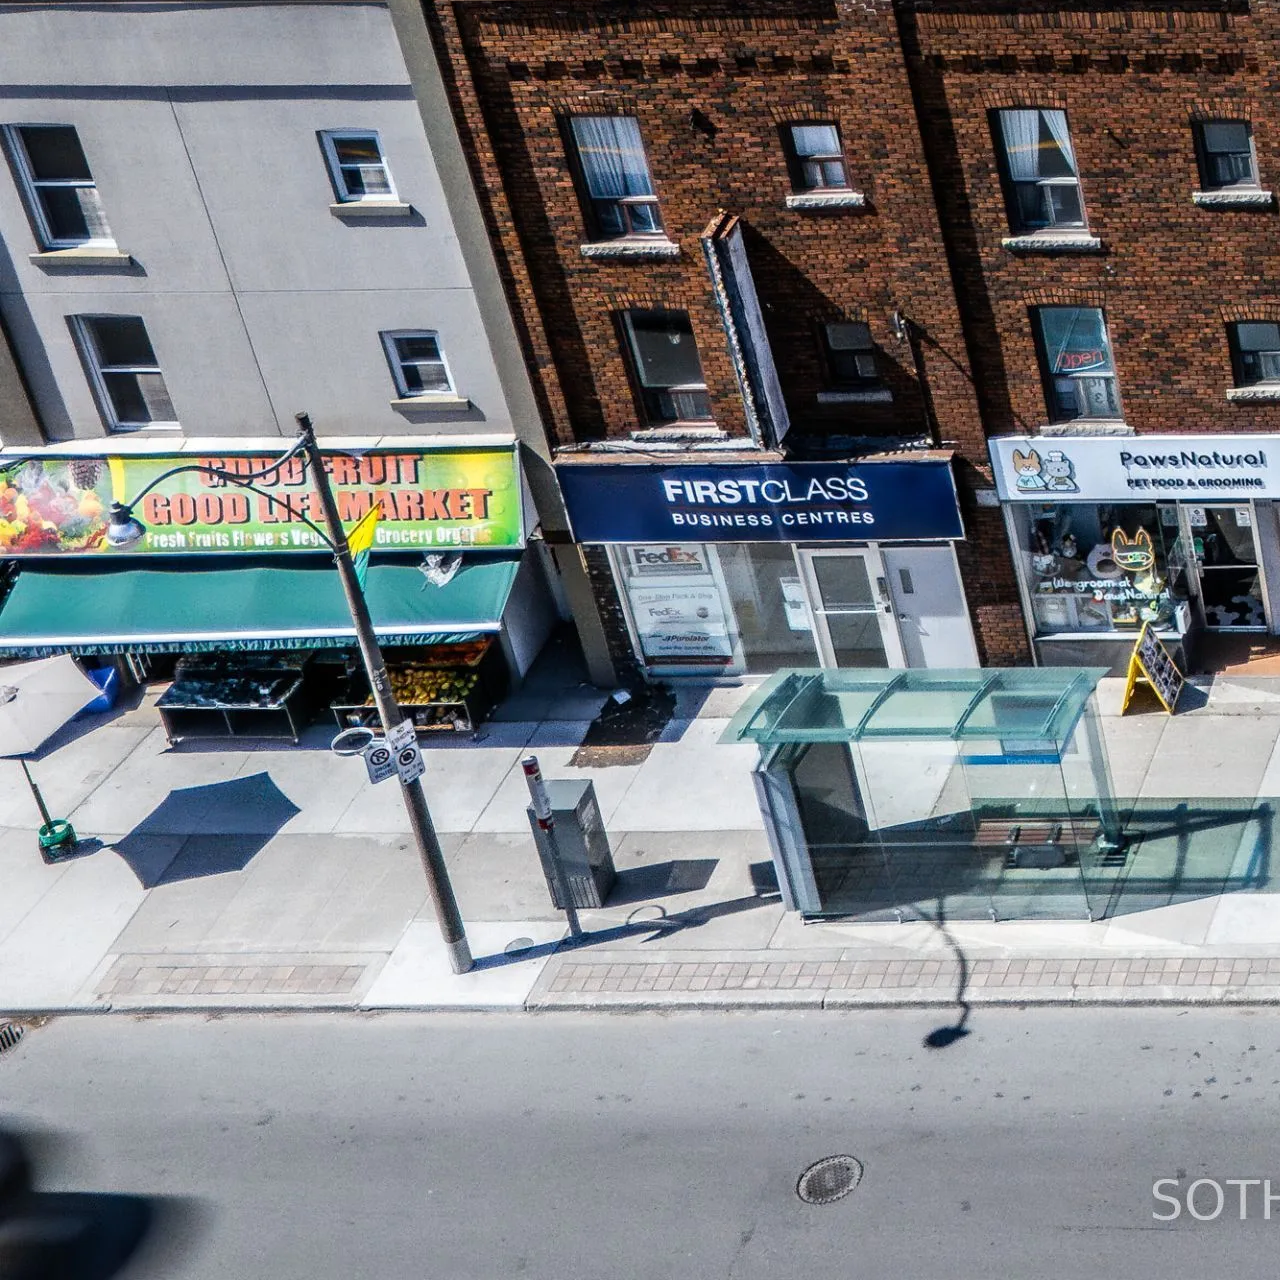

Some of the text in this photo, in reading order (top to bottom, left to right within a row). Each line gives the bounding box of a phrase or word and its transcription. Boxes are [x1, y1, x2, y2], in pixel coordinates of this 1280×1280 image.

[1119, 450, 1266, 467] PawsNatural
[199, 456, 307, 488] GOOD
[663, 477, 869, 504] FIRSTCLASS
[1127, 477, 1263, 487] PET FOOD & GROOMING
[143, 492, 251, 525] GOOD
[336, 488, 493, 522] MARKET
[672, 511, 875, 526] BUSINESS CENTRES
[146, 532, 186, 548] Fresh
[188, 531, 230, 547] Fruits
[232, 530, 289, 547] Flowers
[376, 526, 433, 547] Grocery
[633, 547, 700, 564] FedEx
[1053, 577, 1131, 592] We groom at
[648, 607, 681, 617] FedEx
